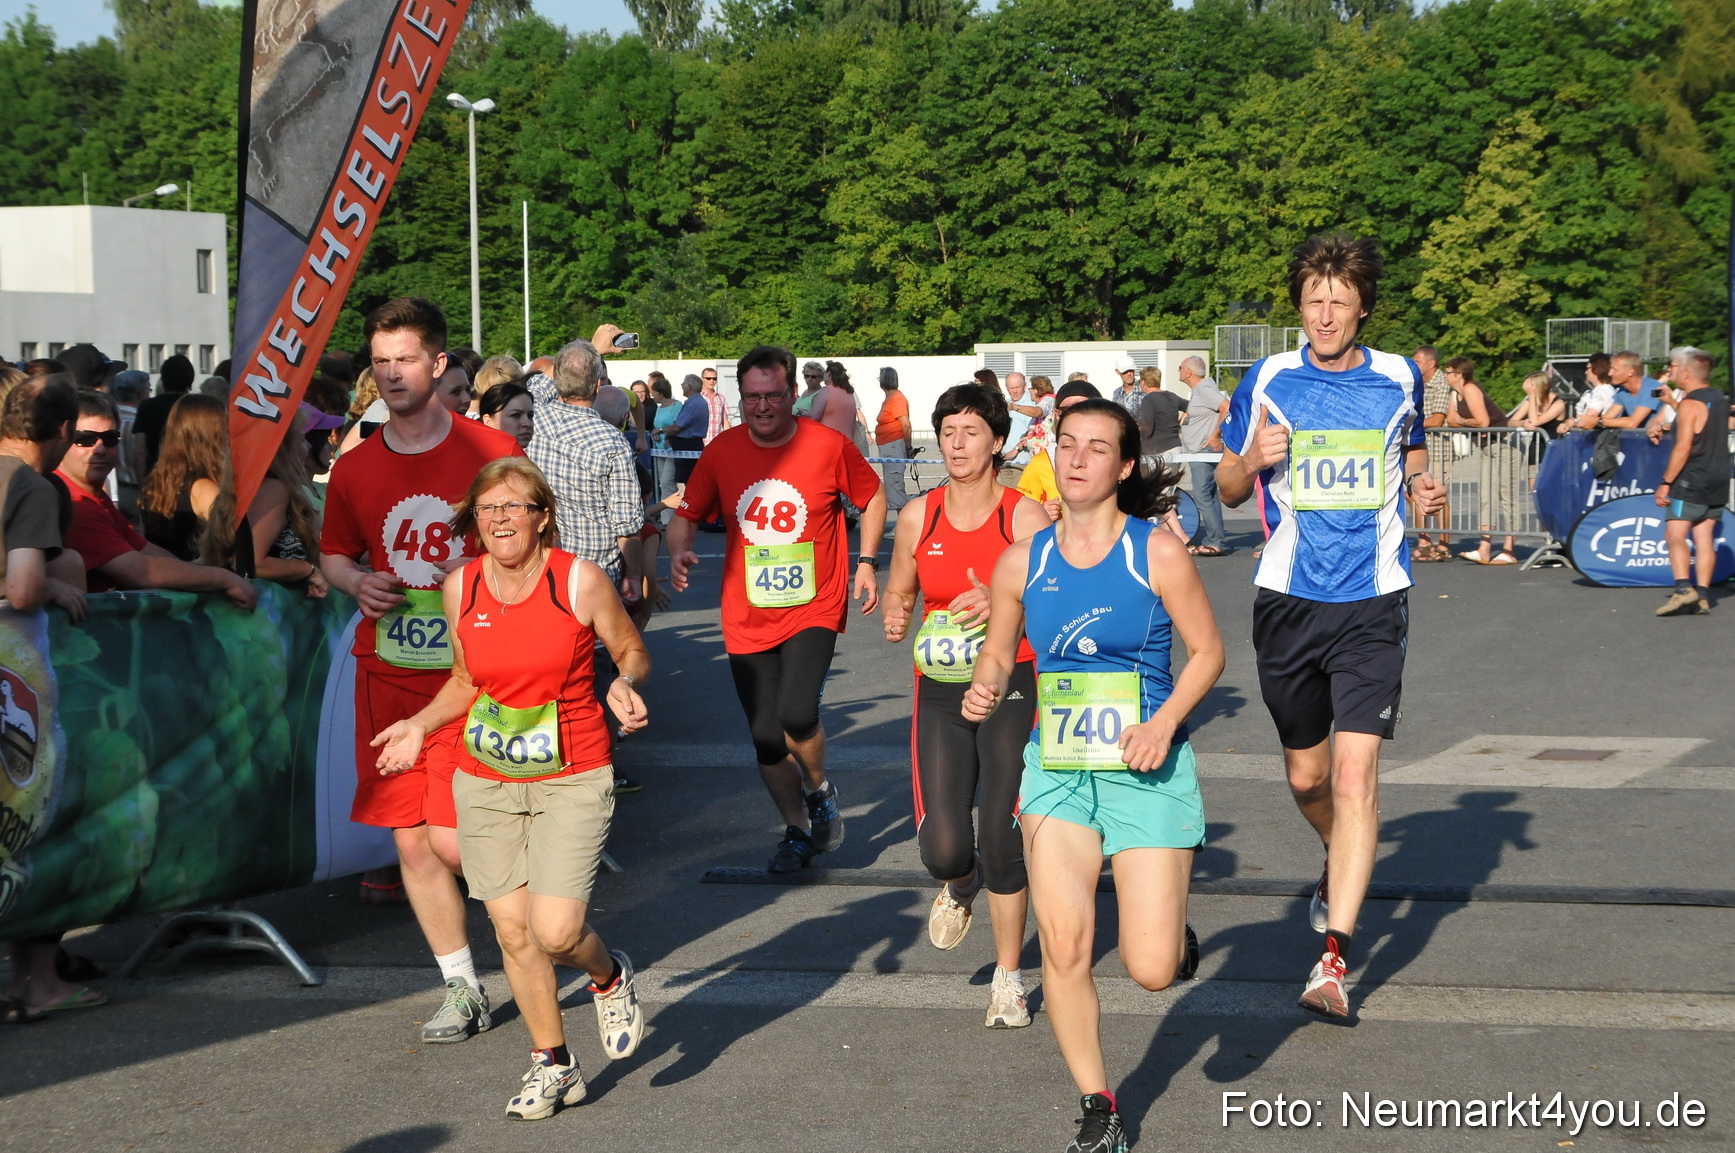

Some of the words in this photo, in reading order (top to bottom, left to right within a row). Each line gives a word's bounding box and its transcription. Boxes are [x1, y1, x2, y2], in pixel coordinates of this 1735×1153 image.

[234, 0, 454, 423] WECHSELSZE
[1296, 457, 1375, 489] 1041
[392, 518, 451, 563] 48
[755, 565, 804, 591] 458
[386, 616, 448, 649] 462
[1048, 633, 1063, 654] Team
[1062, 612, 1090, 634] Schick
[1091, 606, 1113, 616] Bau
[468, 724, 554, 764] 1303
[1051, 707, 1122, 745] 740
